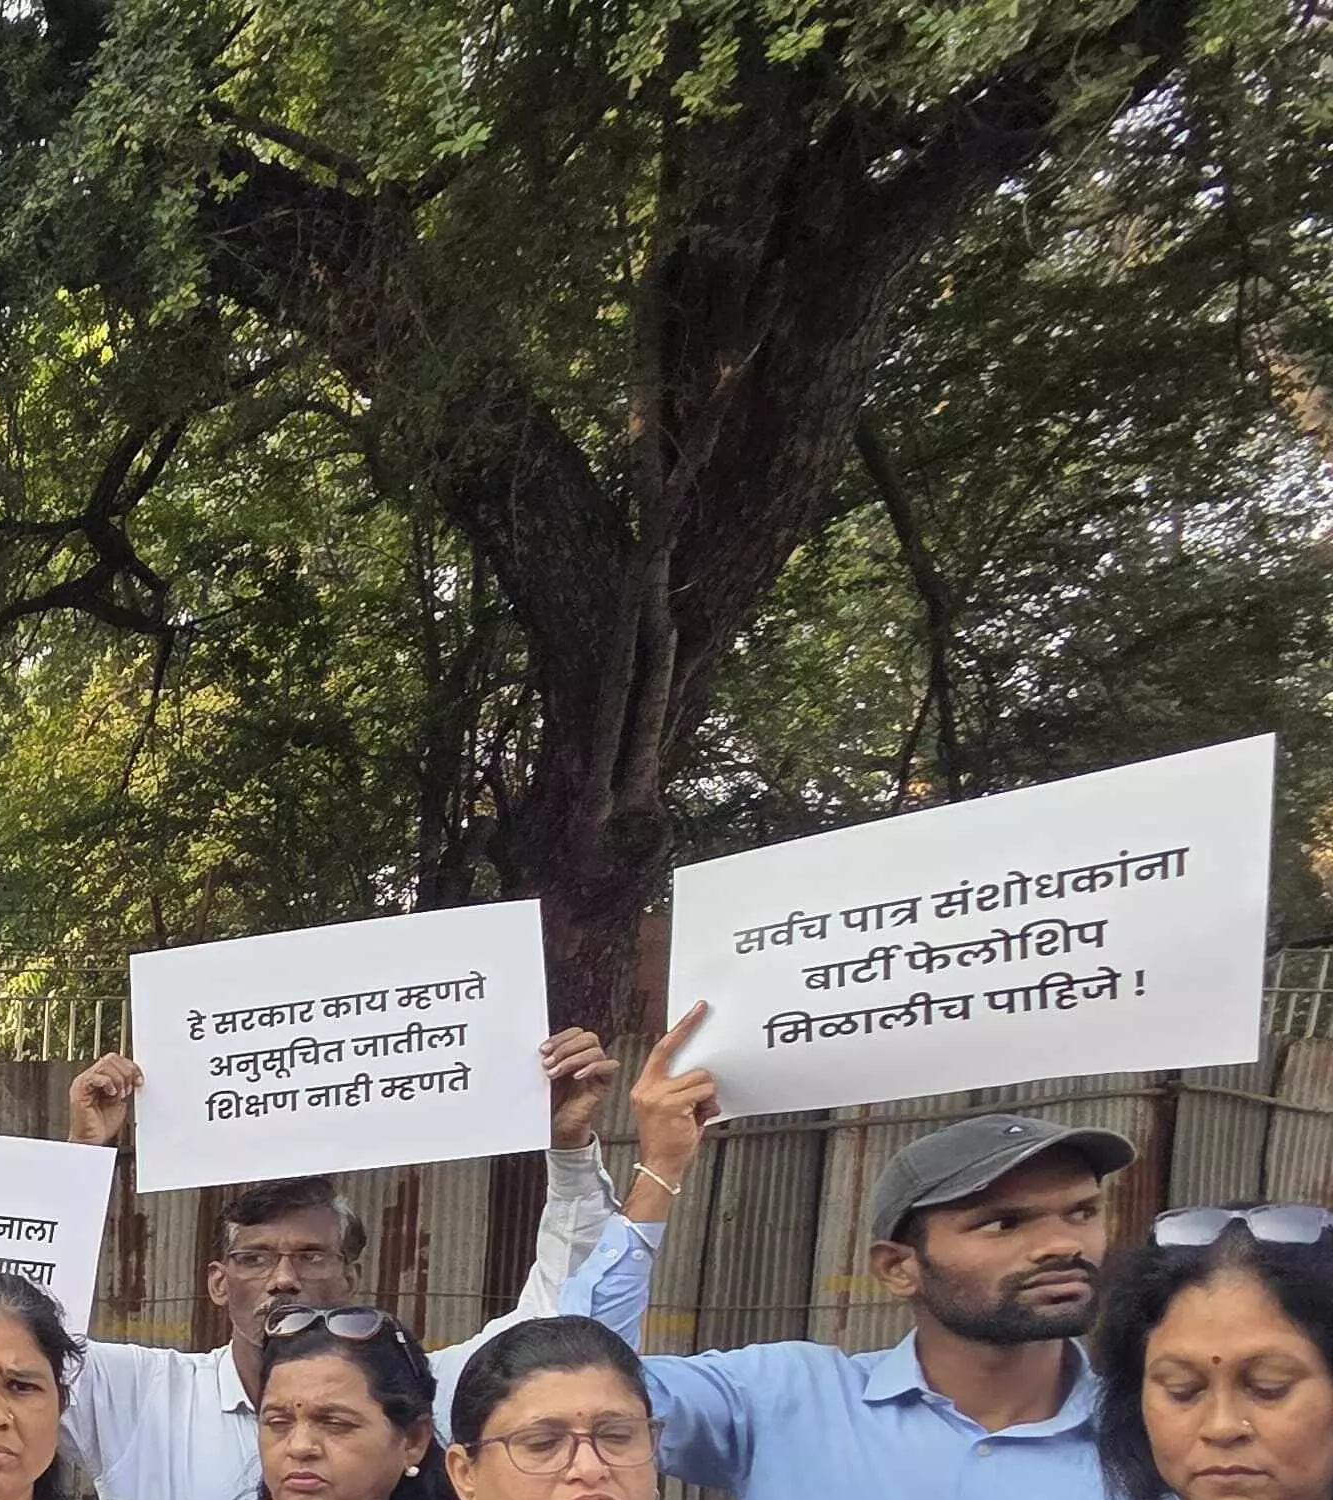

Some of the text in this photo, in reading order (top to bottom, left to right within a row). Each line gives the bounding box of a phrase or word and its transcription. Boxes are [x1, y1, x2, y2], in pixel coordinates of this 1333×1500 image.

[734, 846, 1189, 955] सर्वच पात्र संशोधकांना
[803, 917, 1108, 993] बार्टी फेलोशिप
[187, 971, 486, 1040] हे सरकार काय म्हणते
[763, 966, 1147, 1049] मिळालीच पाहिजे !
[209, 1021, 468, 1078] अनुसूचित जातीला
[205, 1061, 471, 1121] शिक्षण नाही म्हणते
